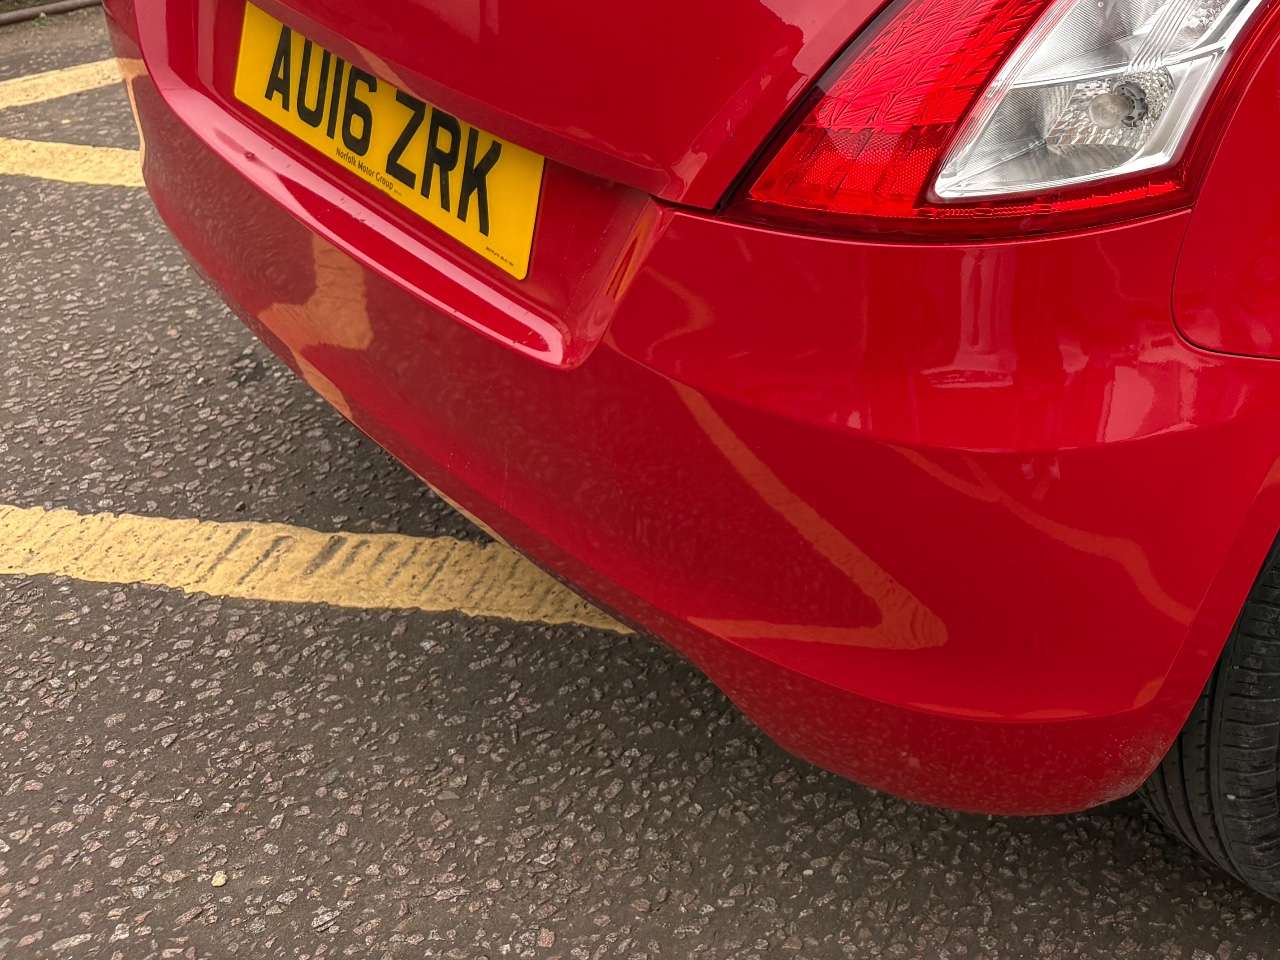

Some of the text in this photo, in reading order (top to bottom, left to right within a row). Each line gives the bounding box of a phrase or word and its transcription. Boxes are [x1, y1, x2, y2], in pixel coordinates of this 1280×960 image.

[264, 23, 503, 238] AU16 ZRK
[357, 160, 376, 178] Motor
[375, 171, 395, 191] Group
